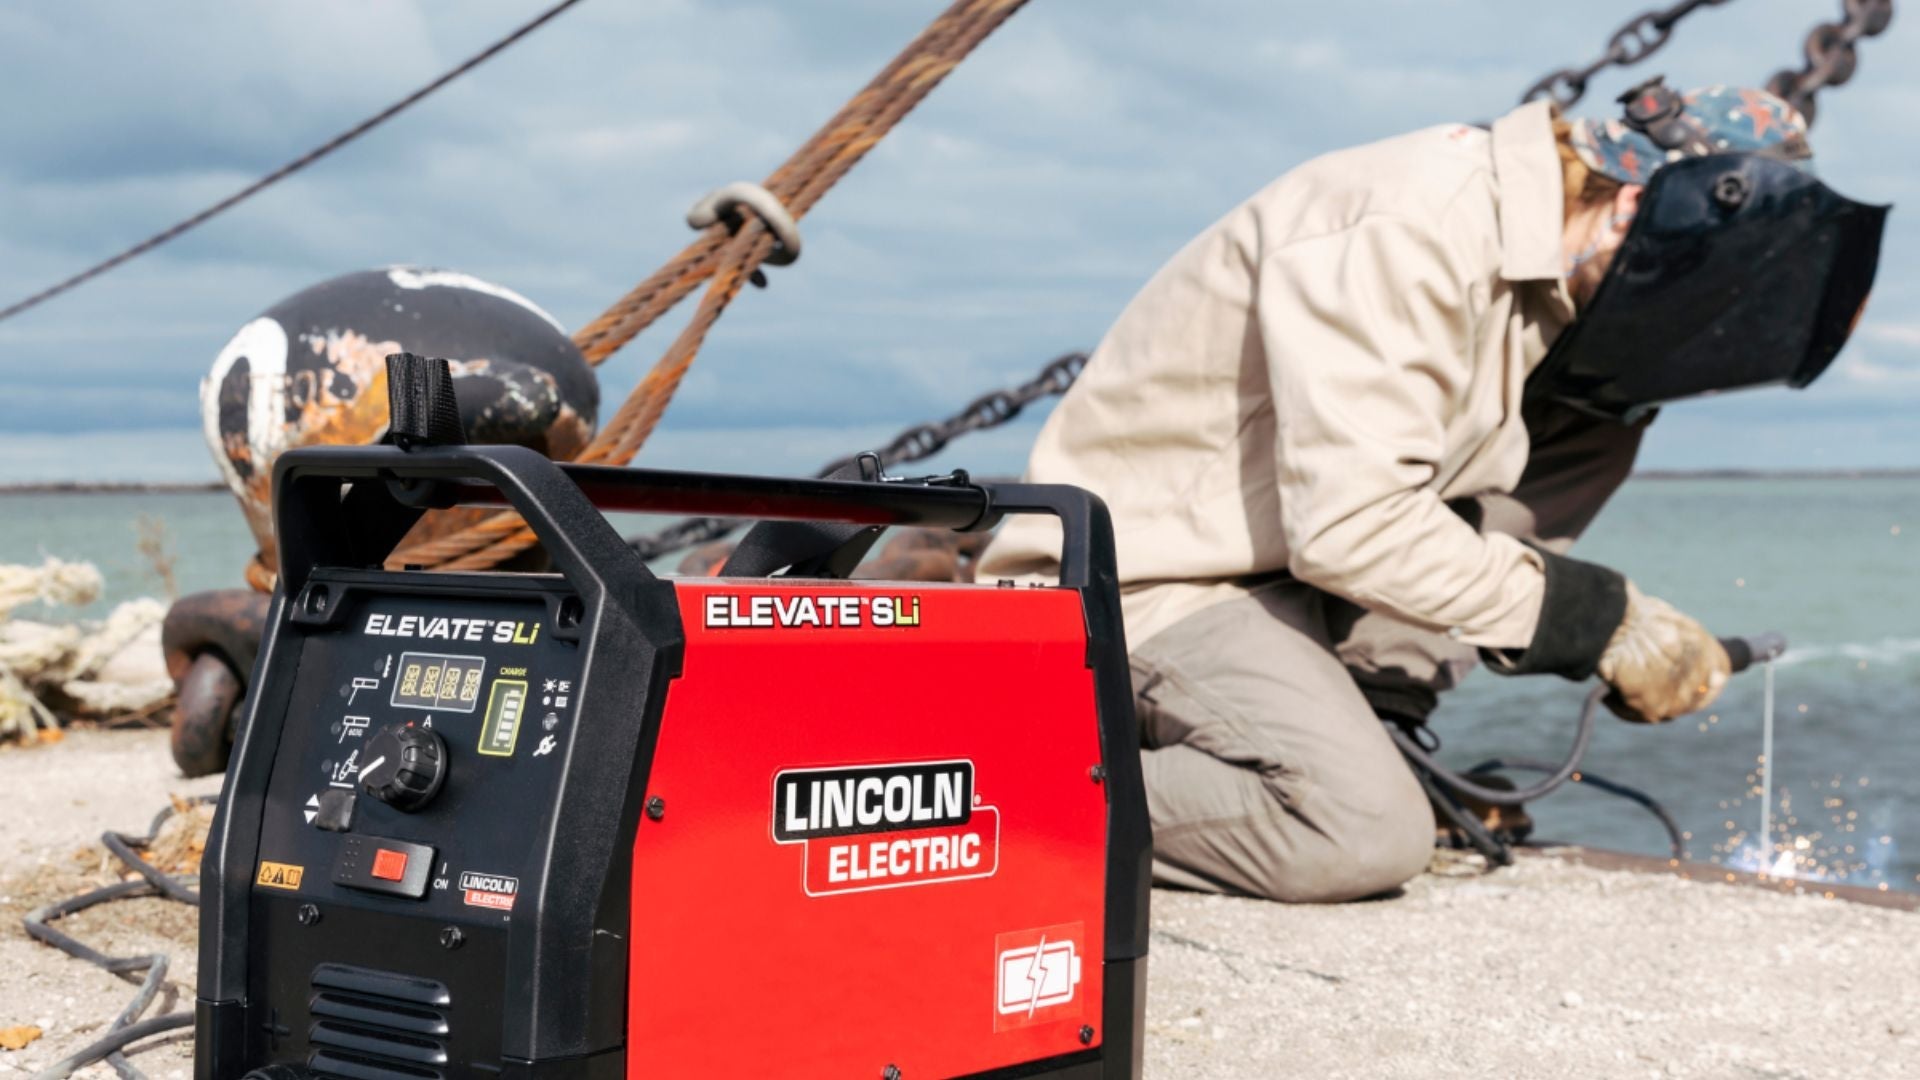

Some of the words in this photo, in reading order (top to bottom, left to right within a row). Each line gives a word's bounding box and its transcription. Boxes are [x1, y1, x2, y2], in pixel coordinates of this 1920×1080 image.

[871, 597, 920, 627] SLi
[492, 621, 541, 645] SLi
[422, 714, 433, 728] A
[785, 771, 963, 832] LINCOLN
[828, 833, 981, 883] ELECTRIC
[433, 879, 449, 890] ON
[462, 875, 515, 894] LINCOLN
